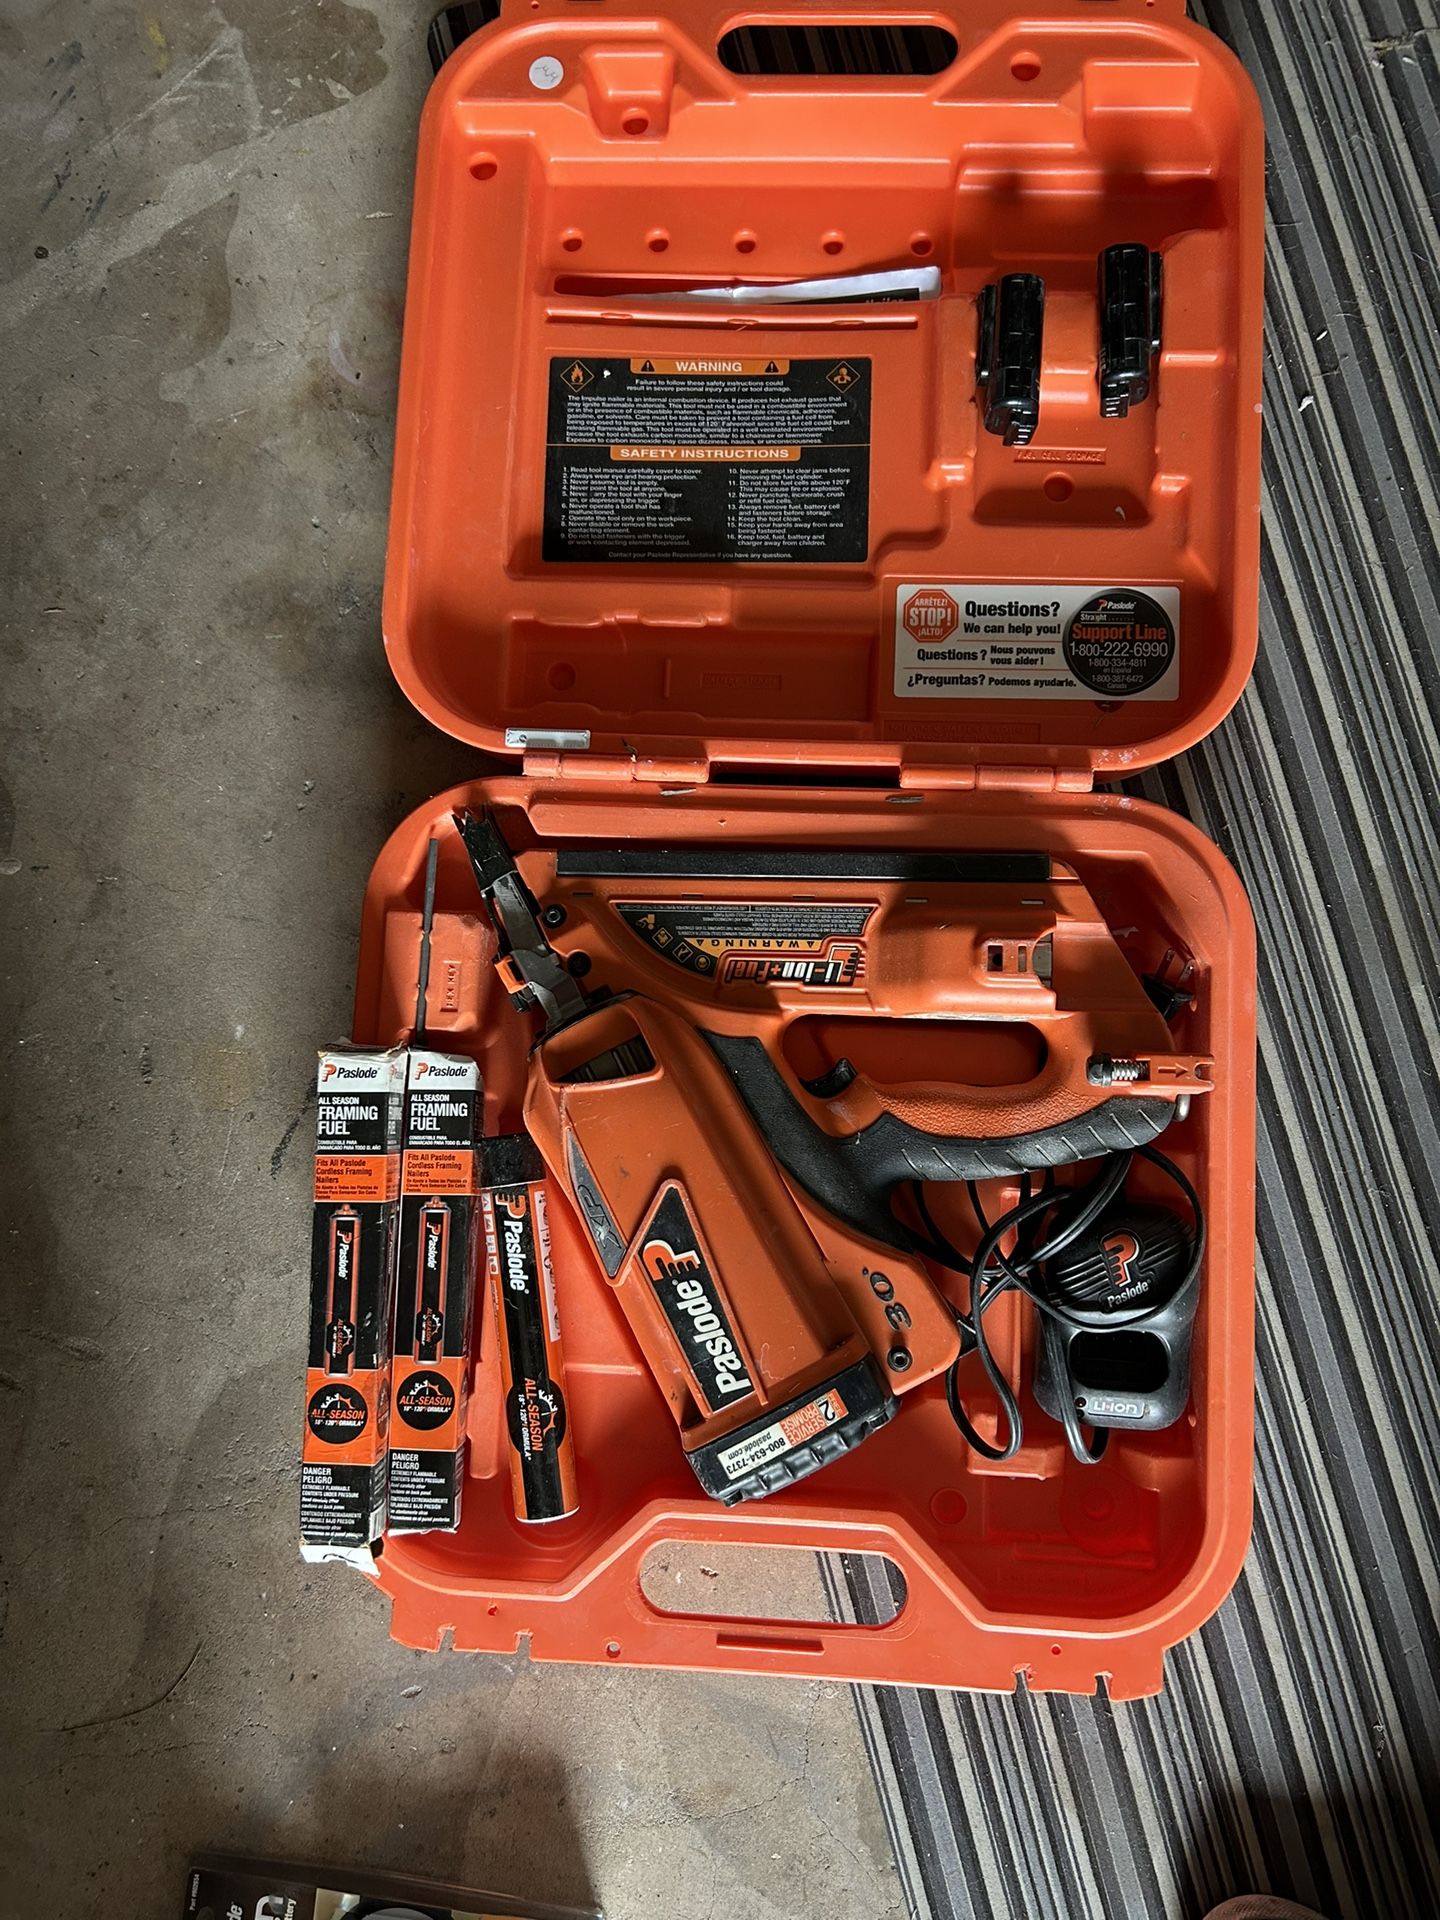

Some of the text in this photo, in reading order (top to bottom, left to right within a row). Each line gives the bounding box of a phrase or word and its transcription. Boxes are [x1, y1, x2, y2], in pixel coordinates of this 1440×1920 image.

[676, 361, 743, 372] WARNING
[620, 449, 789, 459] SAFETY INSTRUCTIONS
[965, 601, 1061, 617] Questions?
[1107, 601, 1135, 610] Paslode
[909, 608, 951, 626] STOP!
[964, 623, 1061, 636] We can help you!
[1072, 623, 1167, 643] Support Line
[917, 649, 978, 661] Questions
[990, 645, 1055, 656] Nous pouvons
[1069, 642, 1168, 657] 1-800-222-6990
[990, 657, 1012, 665] vous
[1015, 656, 1038, 665] aider
[1088, 658, 1147, 667] 1-800-334-4811
[907, 674, 1076, 688] ¿Preguntas? Podemos ayudarle.
[711, 939, 799, 948] WARNING
[337, 1068, 378, 1079] Paslode
[428, 1066, 468, 1077] Paslode
[318, 1097, 360, 1105] ALL SEASON
[411, 1094, 450, 1102] ALL SEASON
[318, 1106, 378, 1121] FRAMING
[411, 1103, 468, 1117] FRAMING
[318, 1121, 350, 1135] FUEL
[410, 1118, 441, 1131] FUEL
[316, 1159, 328, 1167] Fits
[340, 1159, 366, 1167] Paslode
[315, 1176, 339, 1184] Nailers
[577, 1184, 620, 1249] XP
[427, 1234, 439, 1268] Paslode
[503, 1220, 529, 1291] Paslode
[338, 1242, 350, 1277] Paslode
[1107, 1282, 1149, 1308] Paslode
[676, 1279, 751, 1395] Paslode
[400, 1396, 453, 1406] ALL-SEASON
[312, 1408, 366, 1420] ALL-SEASON
[524, 1377, 543, 1451] ALL-SEASON
[818, 1399, 836, 1421] 2
[781, 1404, 819, 1433] PROMISE
[788, 1415, 827, 1444] SERVICE
[727, 1432, 771, 1461] paslode.com
[392, 1453, 419, 1461] DANGER
[727, 1437, 786, 1474] 800-634-7373
[303, 1467, 331, 1475] DANGER
[392, 1461, 419, 1470] PELIGRO
[303, 1476, 332, 1484] PELIGRO
